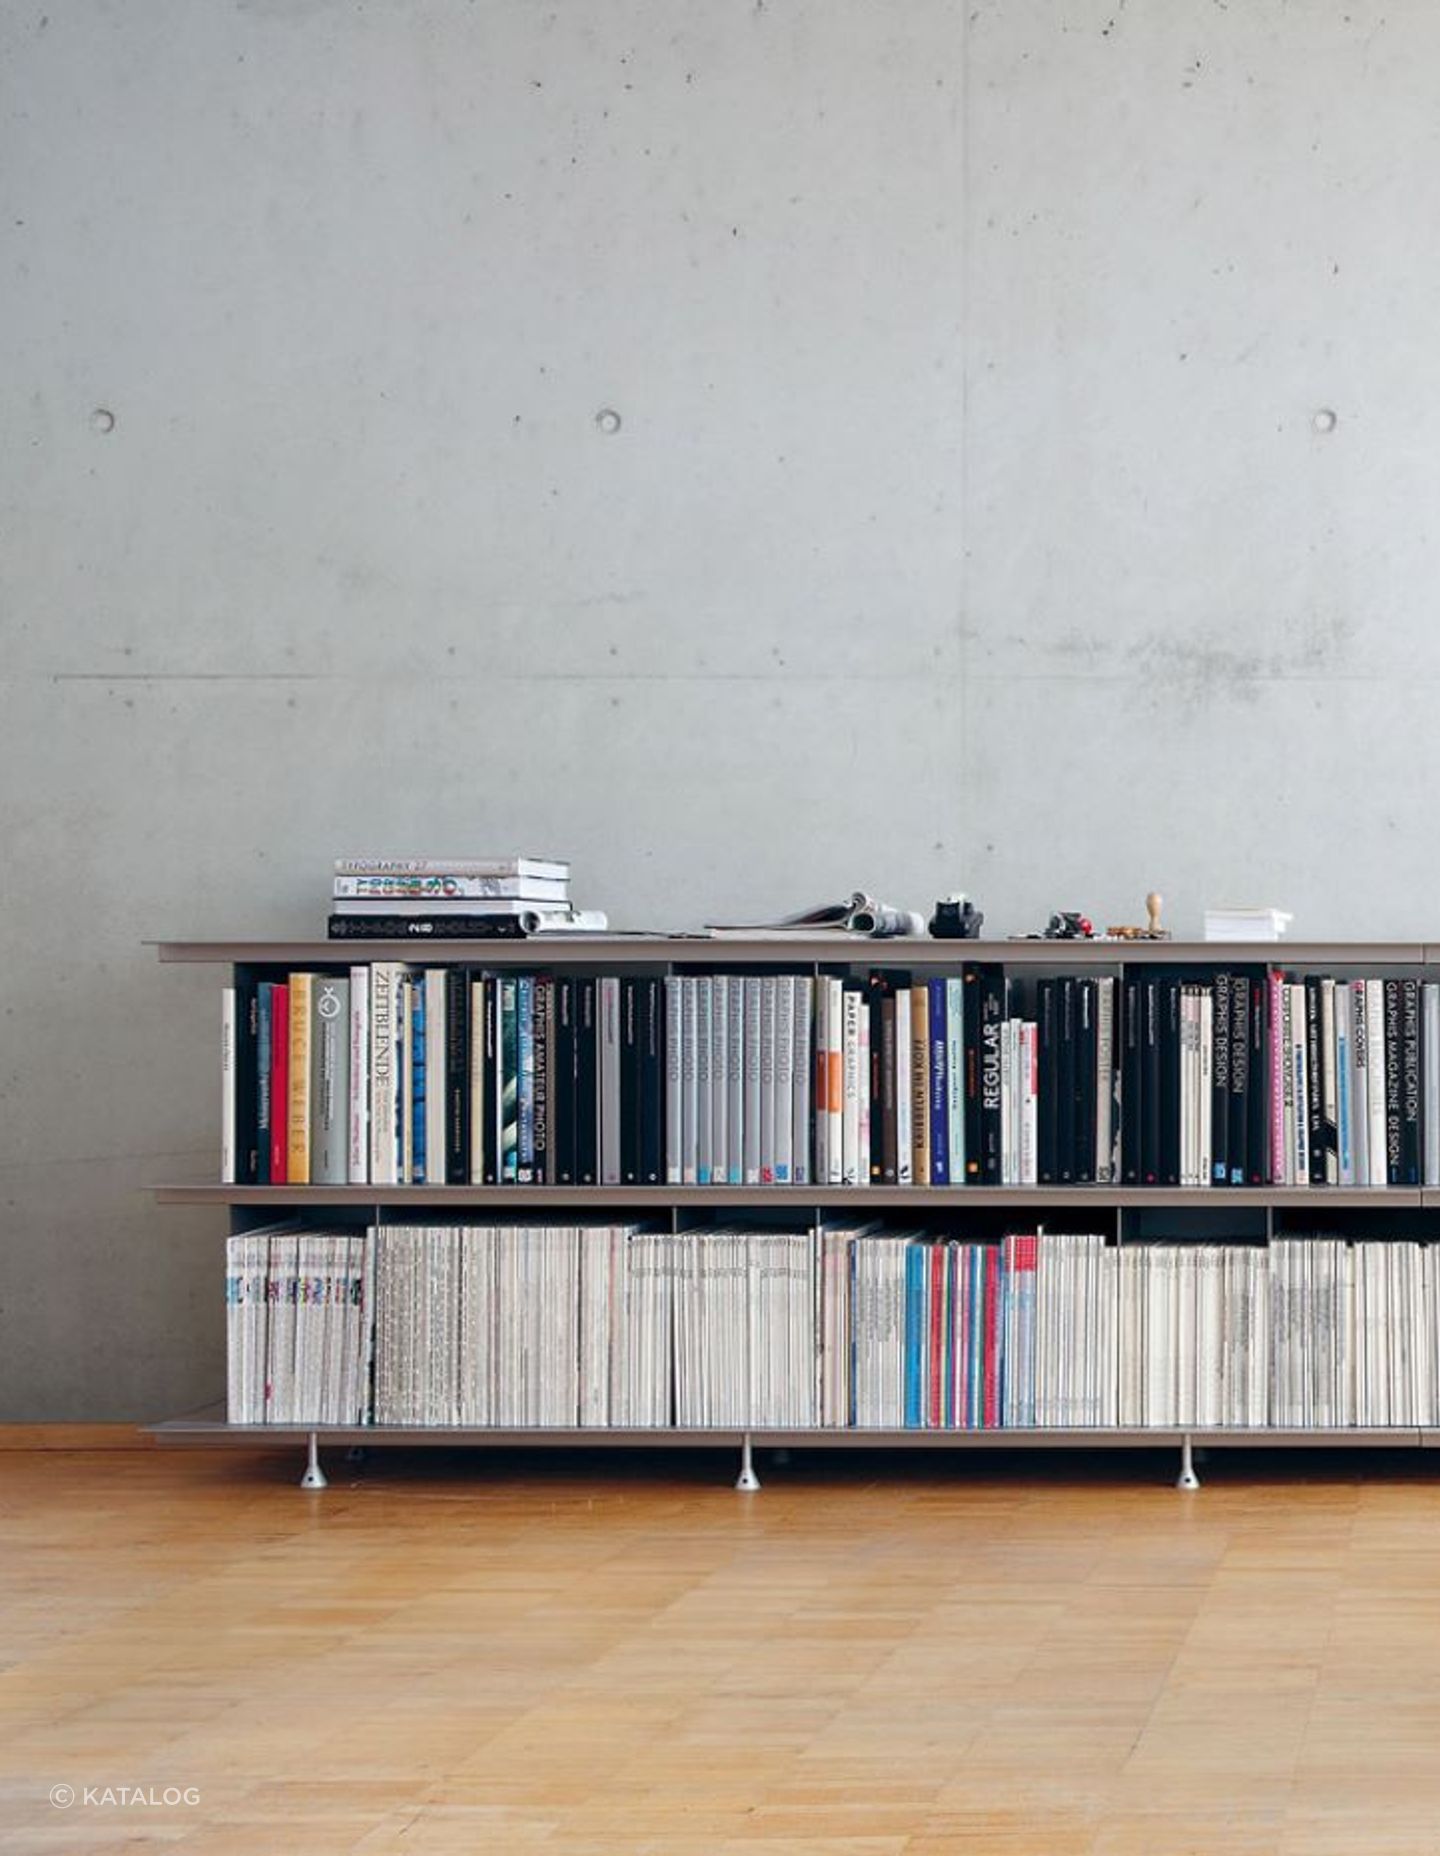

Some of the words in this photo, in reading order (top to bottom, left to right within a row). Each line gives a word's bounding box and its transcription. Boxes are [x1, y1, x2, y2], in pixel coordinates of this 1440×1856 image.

[375, 969, 390, 1088] ZEITBLENDE
[535, 985, 545, 1039] GRAPHIS
[847, 995, 856, 1036] PAPER
[1215, 975, 1229, 1032] GRAPHIS
[1386, 982, 1398, 1037] GRAPHIS
[1404, 981, 1416, 1037] GRAPHIS
[535, 1043, 546, 1102] AMATEUR
[983, 1024, 1000, 1109] REGULAR
[1214, 1038, 1228, 1087] DESIGN
[1232, 1043, 1245, 1094] DESIGN
[1386, 1041, 1399, 1109] MAGAZINE
[1405, 1040, 1418, 1122] PUBLICATION
[536, 1104, 546, 1151] PHOTO
[1388, 1115, 1399, 1166] DESIGN
